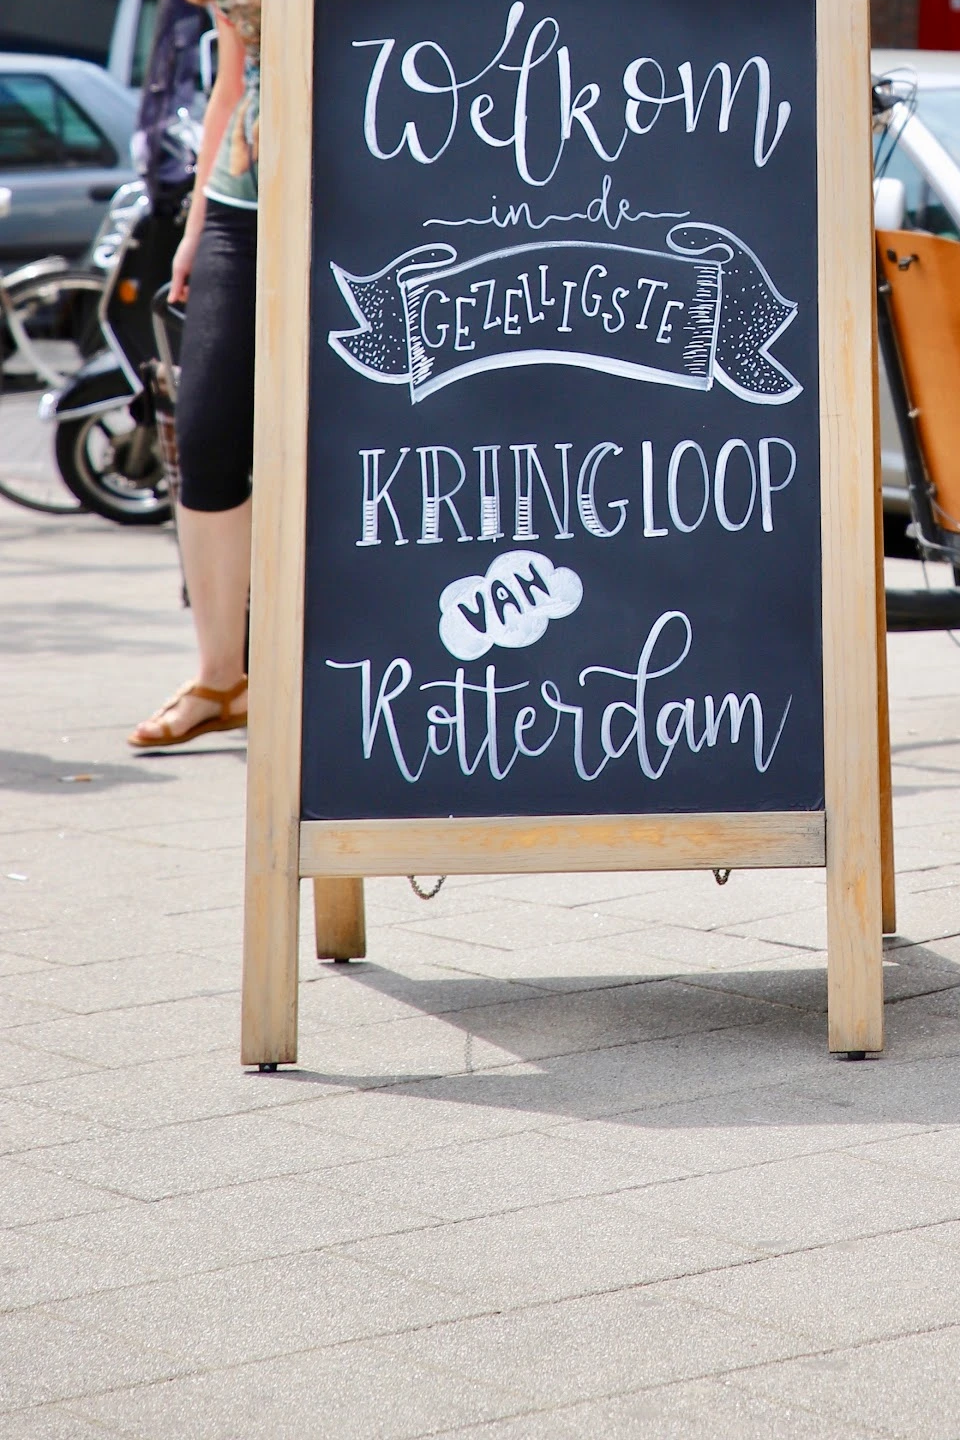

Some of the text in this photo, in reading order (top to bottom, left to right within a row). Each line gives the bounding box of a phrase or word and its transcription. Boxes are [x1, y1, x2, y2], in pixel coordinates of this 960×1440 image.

[352, 1, 792, 186] Welkom
[585, 174, 652, 230] de
[420, 264, 685, 352] GEZELLIGSTE
[457, 560, 552, 634] VAN
[326, 610, 793, 783] Rotterdam
